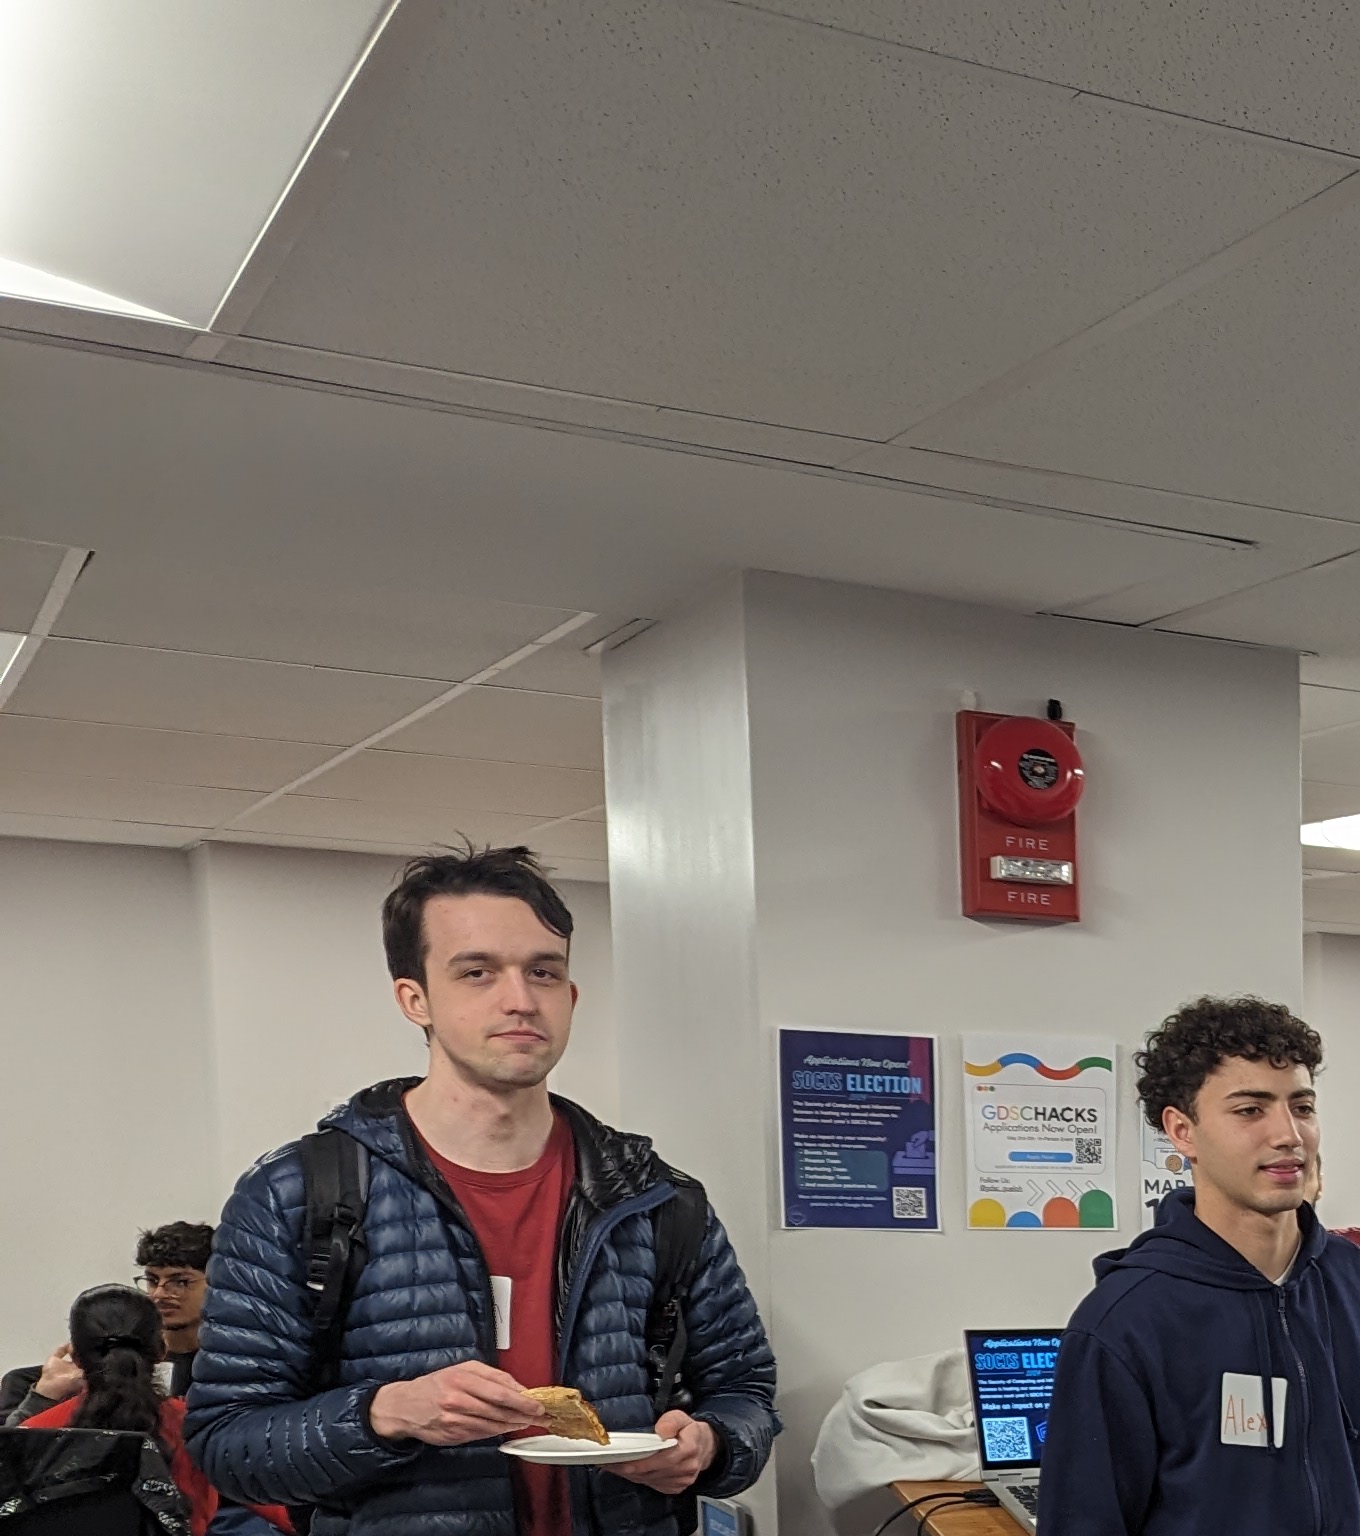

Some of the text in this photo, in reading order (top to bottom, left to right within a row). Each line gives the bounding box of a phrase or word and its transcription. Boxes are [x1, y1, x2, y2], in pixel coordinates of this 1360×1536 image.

[1005, 836, 1049, 851] FIRE
[1007, 890, 1051, 906] FIRE
[792, 1070, 922, 1095] SOCIS ELECTION
[981, 1104, 1098, 1123] GDSCHACKS
[983, 1122, 1098, 1136] Applications Now Open!
[983, 1339, 1032, 1349] Applications
[1032, 1339, 1051, 1347] Now
[974, 1353, 1020, 1370] SOCIS
[1223, 1394, 1268, 1436] Alex
